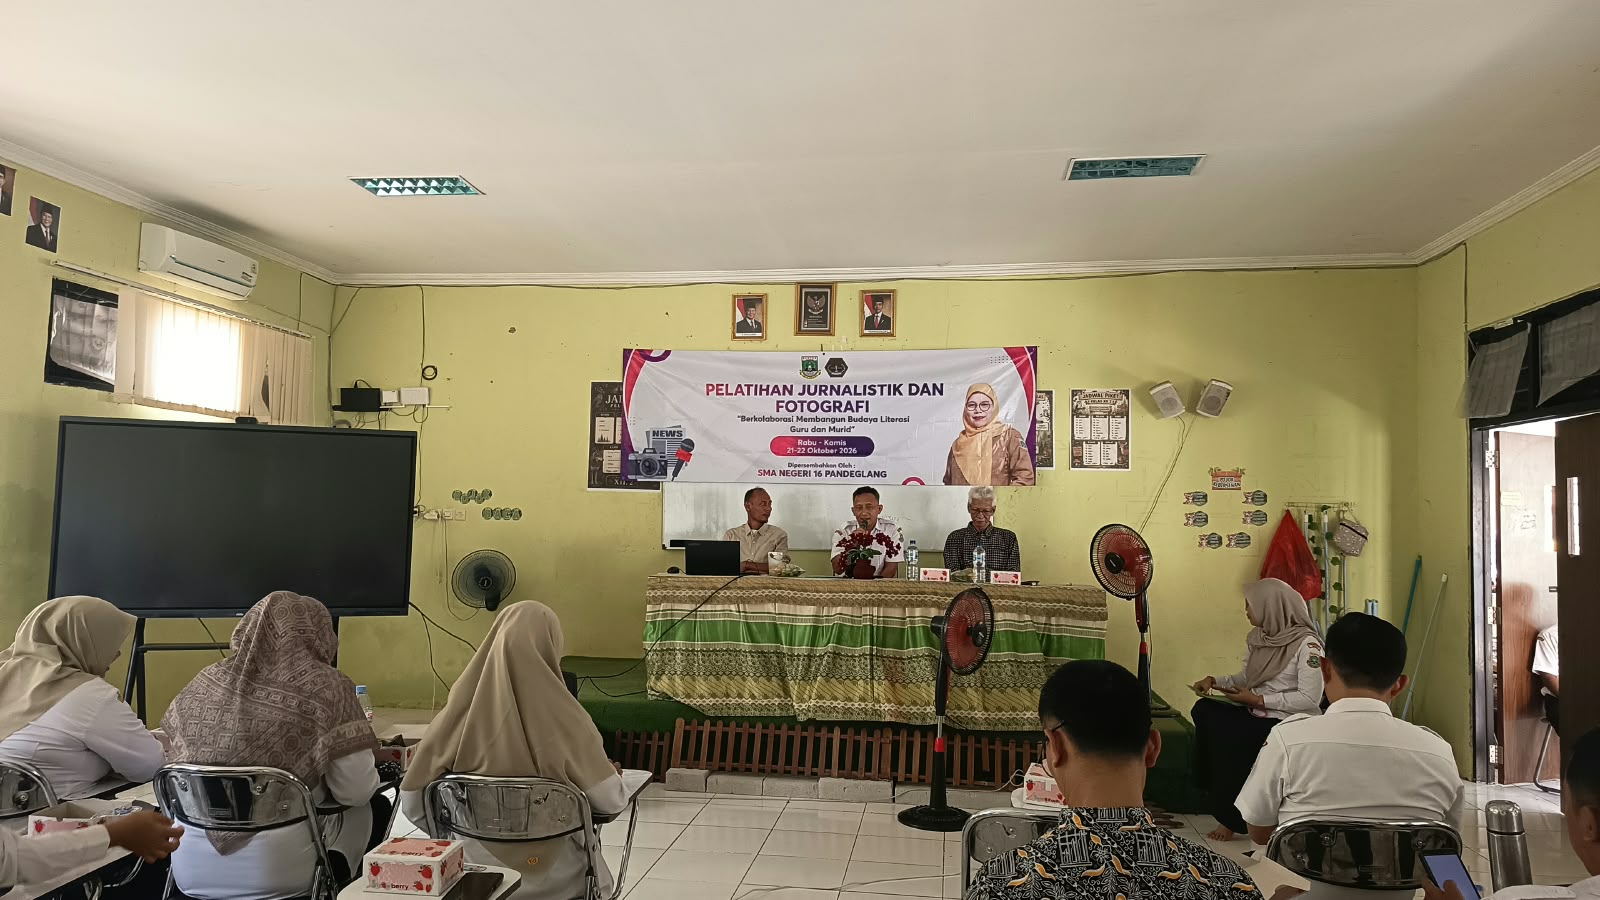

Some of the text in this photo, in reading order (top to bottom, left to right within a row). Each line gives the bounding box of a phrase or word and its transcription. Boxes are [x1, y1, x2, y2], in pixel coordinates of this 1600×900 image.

[705, 382, 944, 397] PELATIHAN JURNALISTIK DAN
[775, 400, 870, 413] FOTOGRAFI
[737, 414, 910, 425] "Berkolaborasi Membangun Budaya Literasi
[789, 425, 855, 433] Guru dan Murid"
[757, 469, 777, 477] SMA
[824, 470, 888, 478] PANDEGLANG
